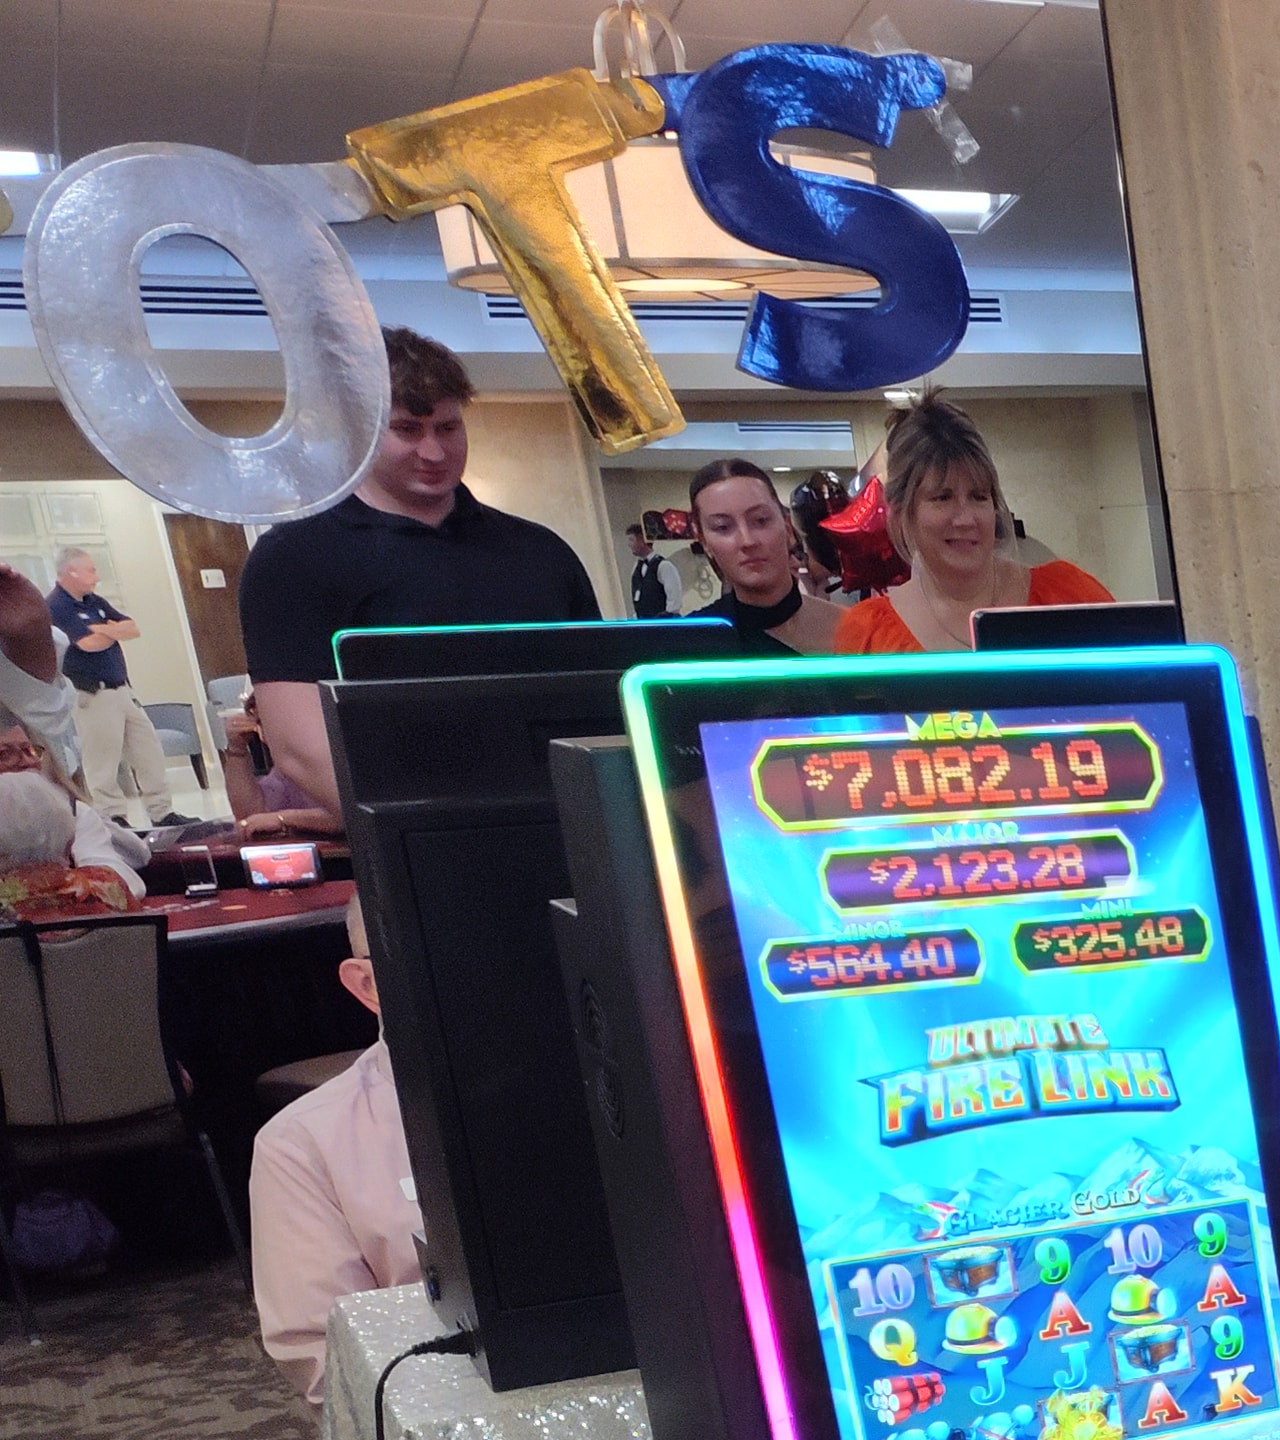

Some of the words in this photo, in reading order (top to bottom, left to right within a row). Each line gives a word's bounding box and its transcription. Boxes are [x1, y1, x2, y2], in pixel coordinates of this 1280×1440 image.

[906, 712, 1002, 740] MEGA
[803, 740, 1108, 808] $7,082.19
[932, 822, 1019, 845] MAJOR
[868, 845, 1085, 899] $2,123.28
[835, 920, 906, 942] MINOR
[1081, 899, 1134, 918] MINI
[787, 938, 955, 987] $564.40
[1033, 917, 1184, 965] $325.48
[926, 1014, 1109, 1065] ULTIMATE
[879, 1059, 1025, 1135] FIRE
[1031, 1048, 1172, 1104] LINK
[949, 1201, 1070, 1237] GLACIER
[1071, 1188, 1141, 1216] GOLD
[1193, 1212, 1228, 1259] 9
[1034, 1237, 1071, 1285] 9
[1104, 1222, 1163, 1276] 10
[848, 1264, 916, 1318] 10
[1197, 1265, 1247, 1312] A
[1040, 1291, 1093, 1340] A
[1210, 1315, 1246, 1360] 9
[869, 1318, 917, 1366] Q
[1052, 1341, 1091, 1390] J
[969, 1357, 1008, 1406] J
[1138, 1380, 1189, 1429] A
[1210, 1365, 1261, 1414] K
